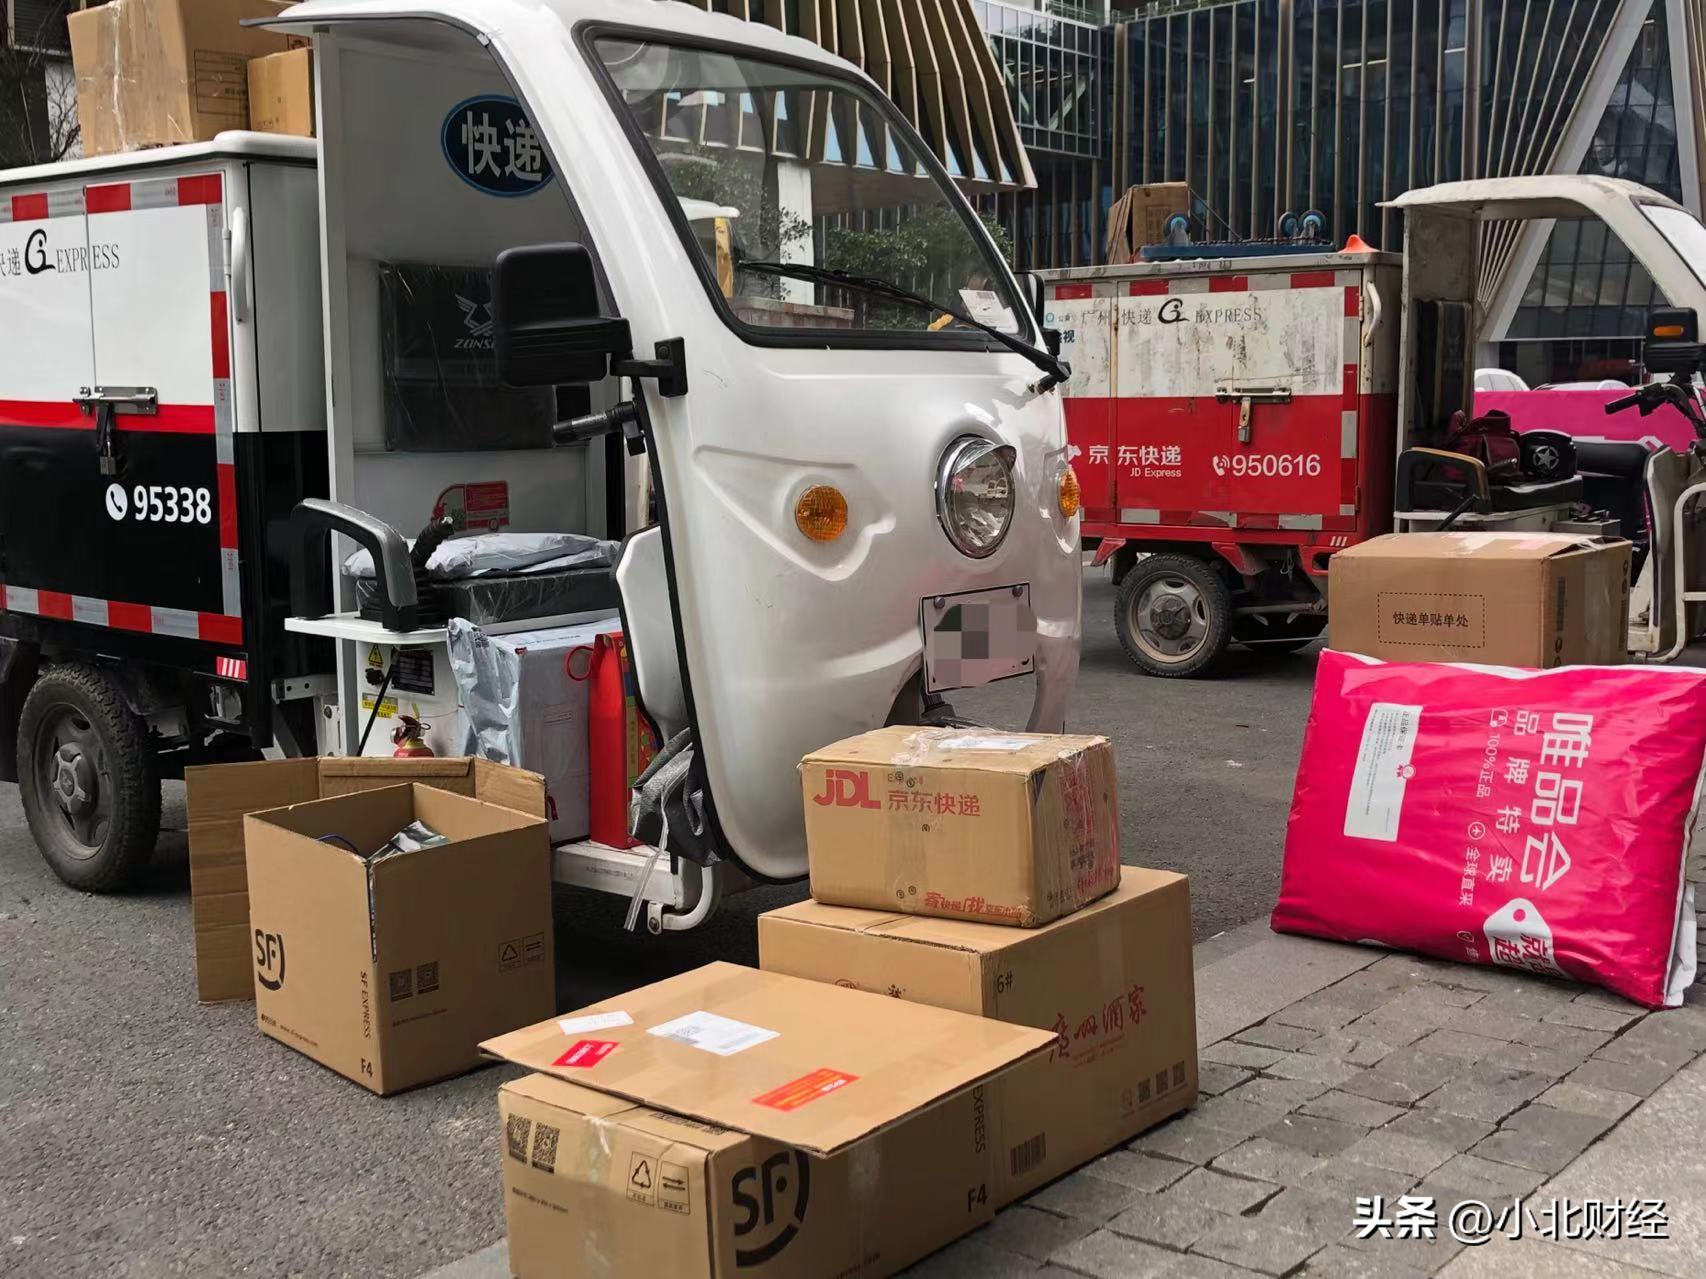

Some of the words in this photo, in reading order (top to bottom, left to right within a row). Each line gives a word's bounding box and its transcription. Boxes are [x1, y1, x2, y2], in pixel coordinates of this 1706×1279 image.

[461, 110, 543, 181] 快递
[56, 243, 120, 274] EXPRESS
[1088, 445, 1182, 466] 京东快递
[1130, 468, 1141, 477] JD
[1144, 467, 1182, 478] Express
[1232, 454, 1321, 476] 950616
[133, 485, 212, 524] 95338
[1392, 611, 1469, 628] 快递单贴单处
[1476, 734, 1500, 798] 100%正品
[814, 769, 882, 810] JDL
[887, 790, 981, 817] 京东快递
[1486, 710, 1540, 883] 品牌特卖
[1520, 712, 1594, 891] 唯品会
[1459, 846, 1481, 906] 全球直采
[360, 970, 368, 988] SF
[361, 989, 372, 1040] EXPRESS
[361, 1057, 374, 1079] F4
[731, 1151, 791, 1237] SF
[967, 1183, 988, 1213] F4
